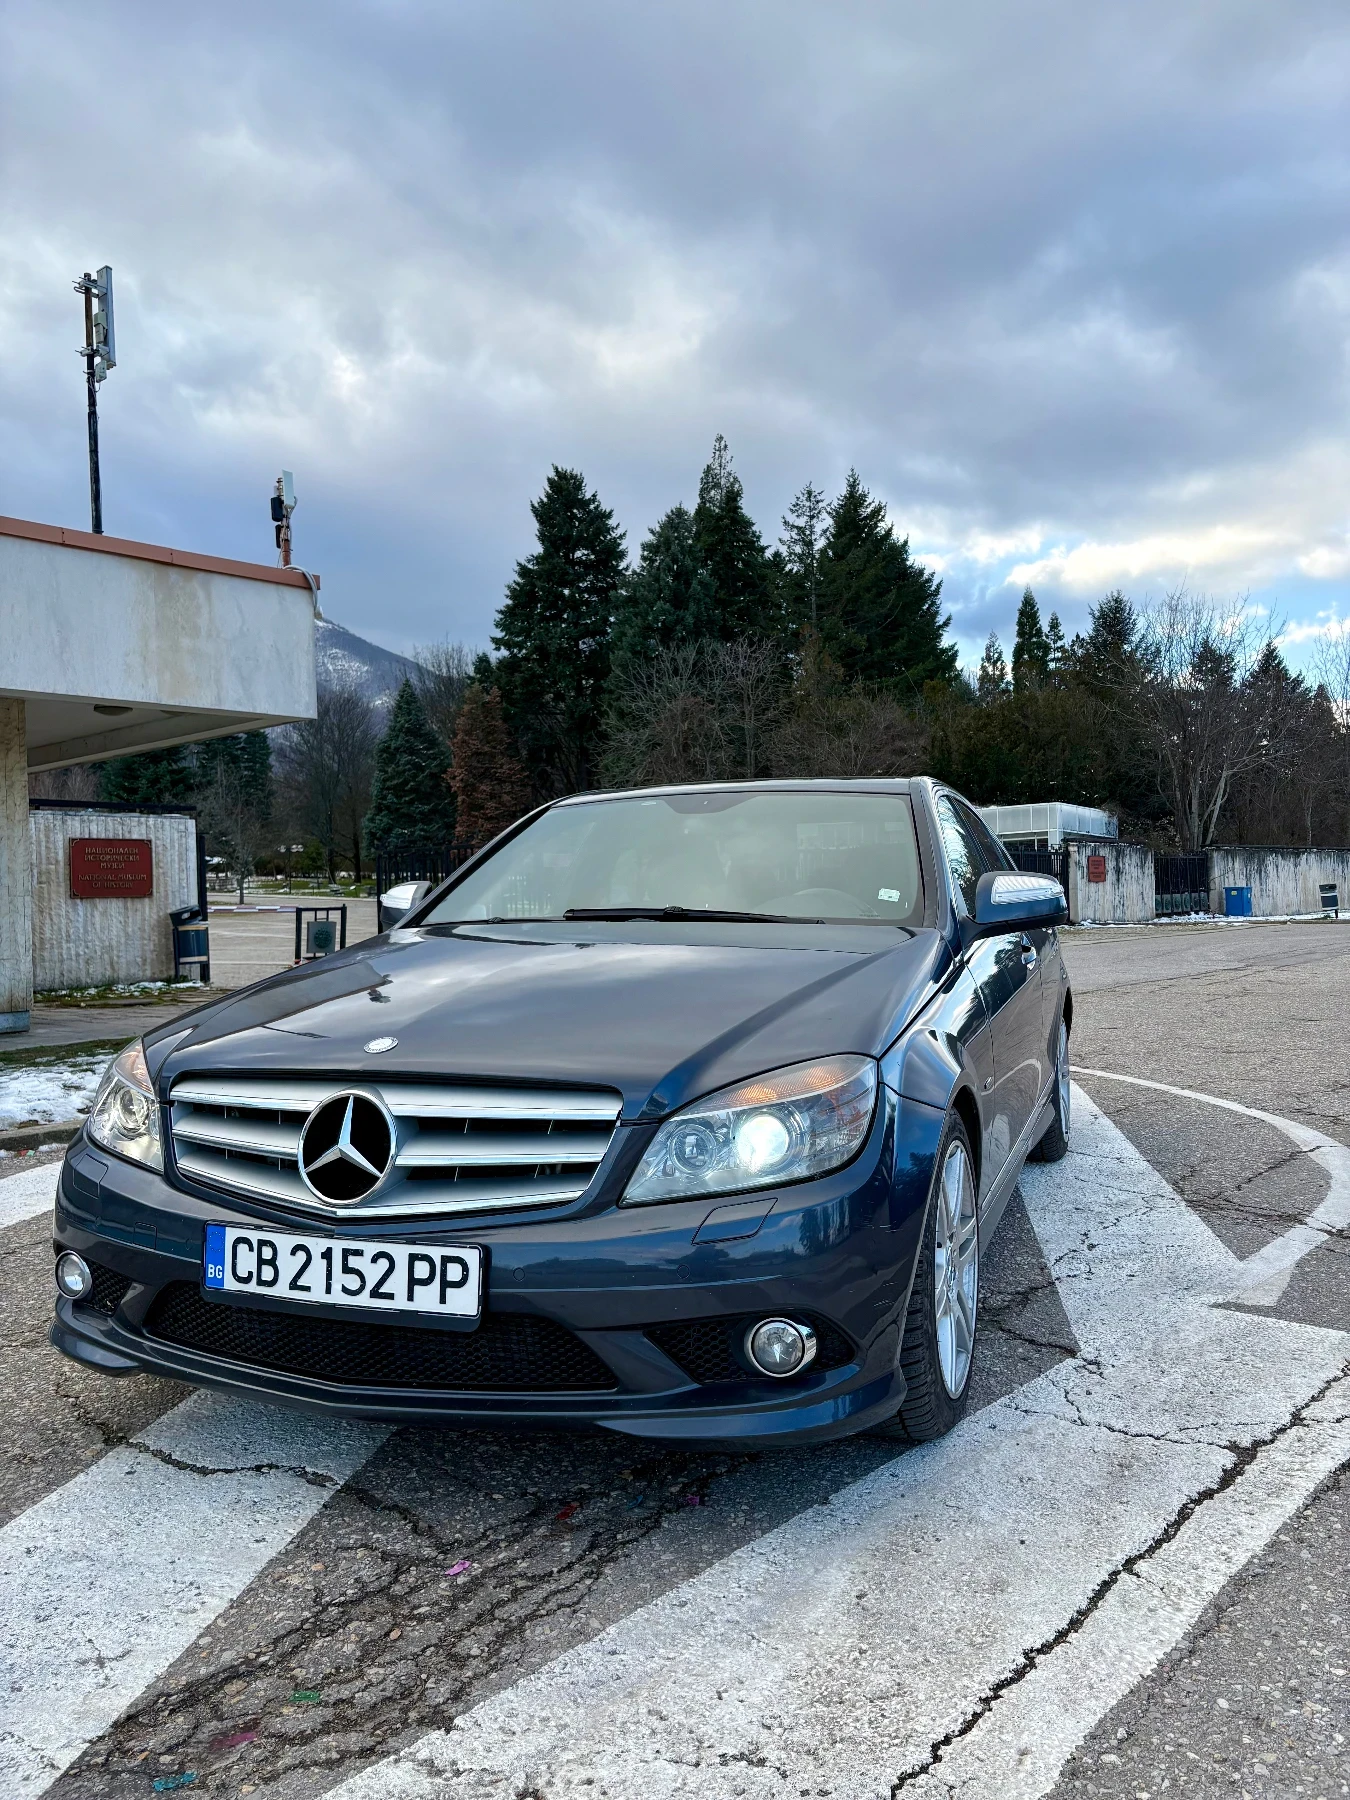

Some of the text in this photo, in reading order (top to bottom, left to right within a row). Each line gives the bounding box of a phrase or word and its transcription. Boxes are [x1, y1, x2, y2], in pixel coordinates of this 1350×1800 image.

[207, 1263, 223, 1279] BG
[231, 1236, 470, 1305] CB 2152 PP
